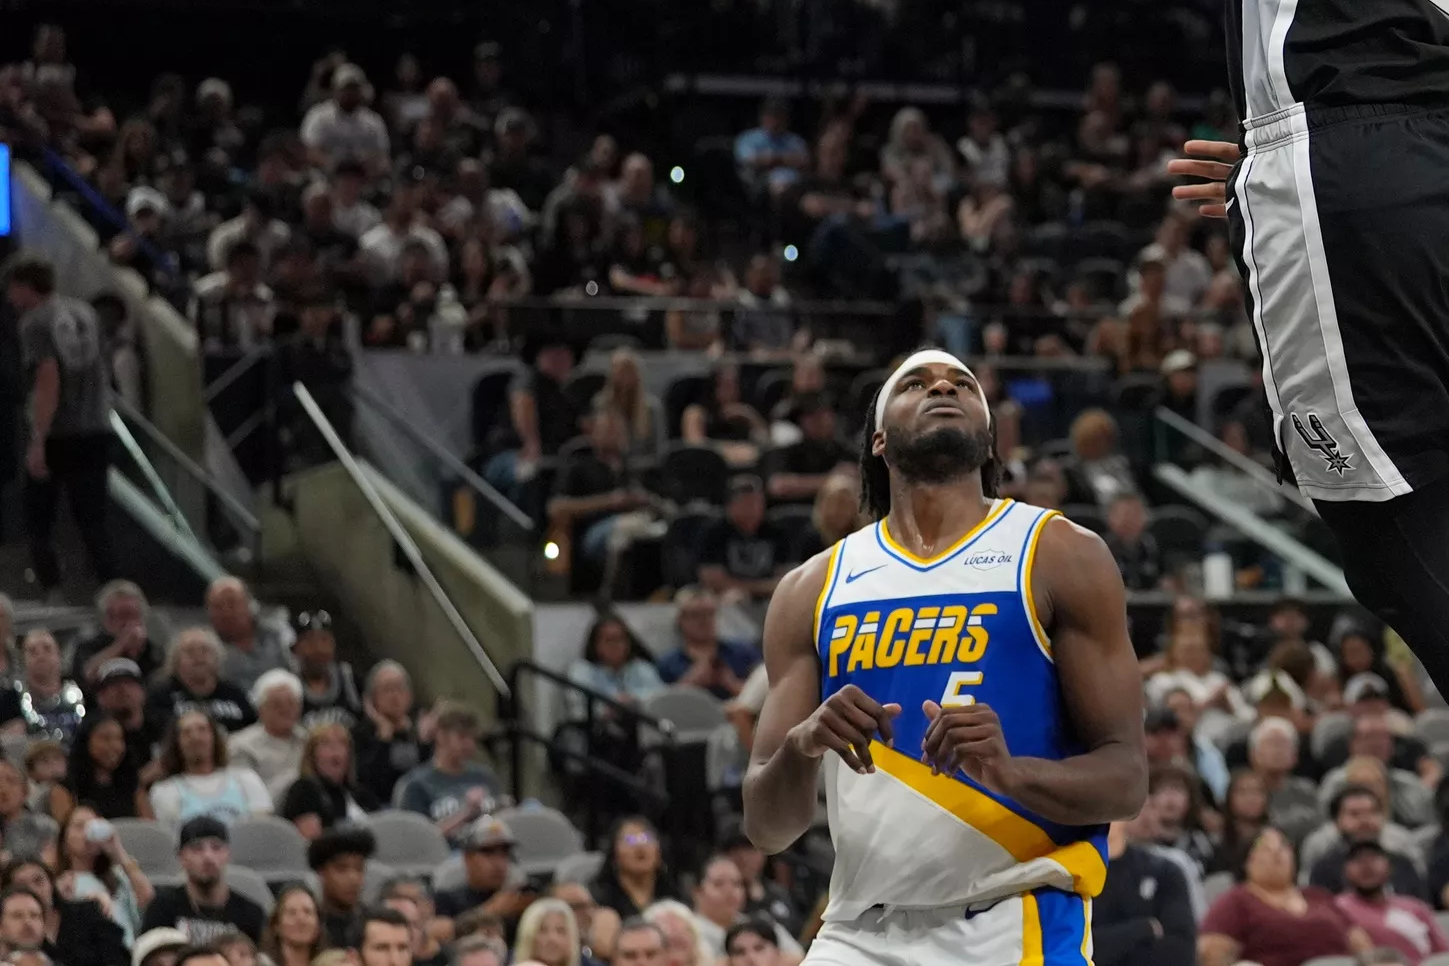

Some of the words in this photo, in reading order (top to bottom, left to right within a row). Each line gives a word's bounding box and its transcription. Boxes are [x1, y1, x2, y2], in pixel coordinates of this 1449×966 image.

[963, 555, 996, 566] LUCAS
[996, 554, 1012, 564] OIL
[828, 602, 999, 678] PACERS
